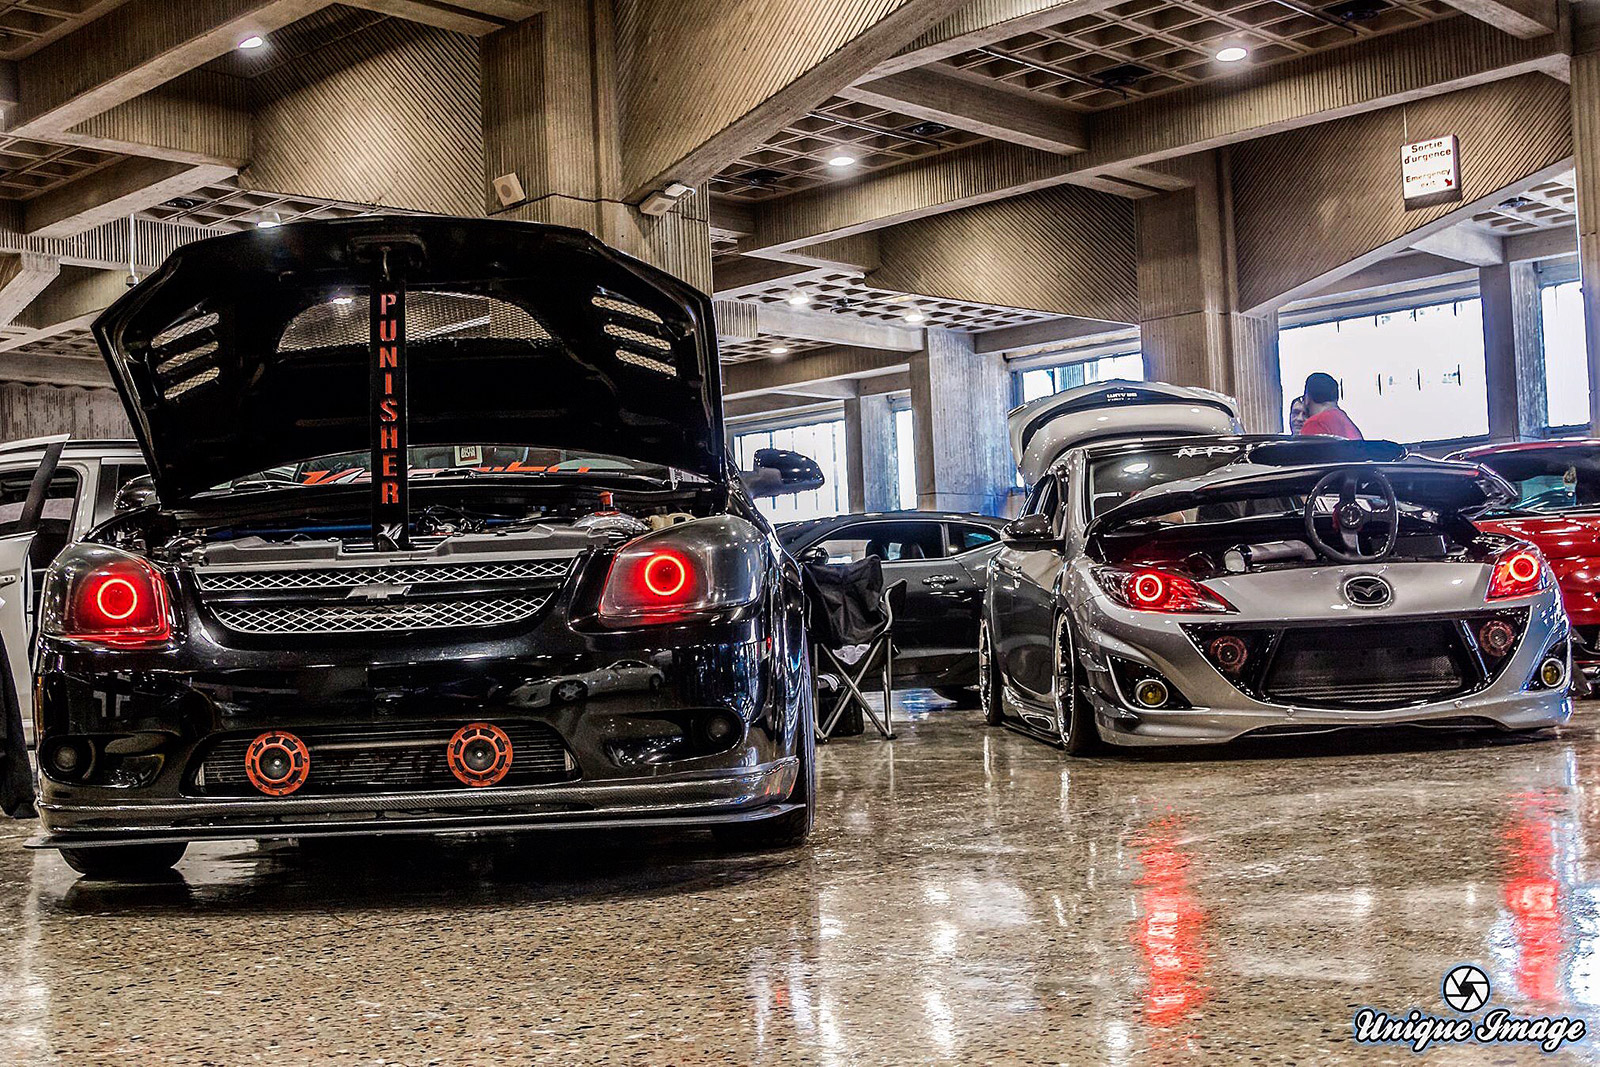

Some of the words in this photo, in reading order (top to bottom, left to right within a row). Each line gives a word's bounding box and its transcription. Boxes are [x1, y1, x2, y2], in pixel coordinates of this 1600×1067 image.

[1411, 141, 1442, 153] Sortie
[1404, 149, 1451, 164] d'urgence
[1406, 169, 1450, 182] Emergency
[379, 294, 399, 504] PUNISHER
